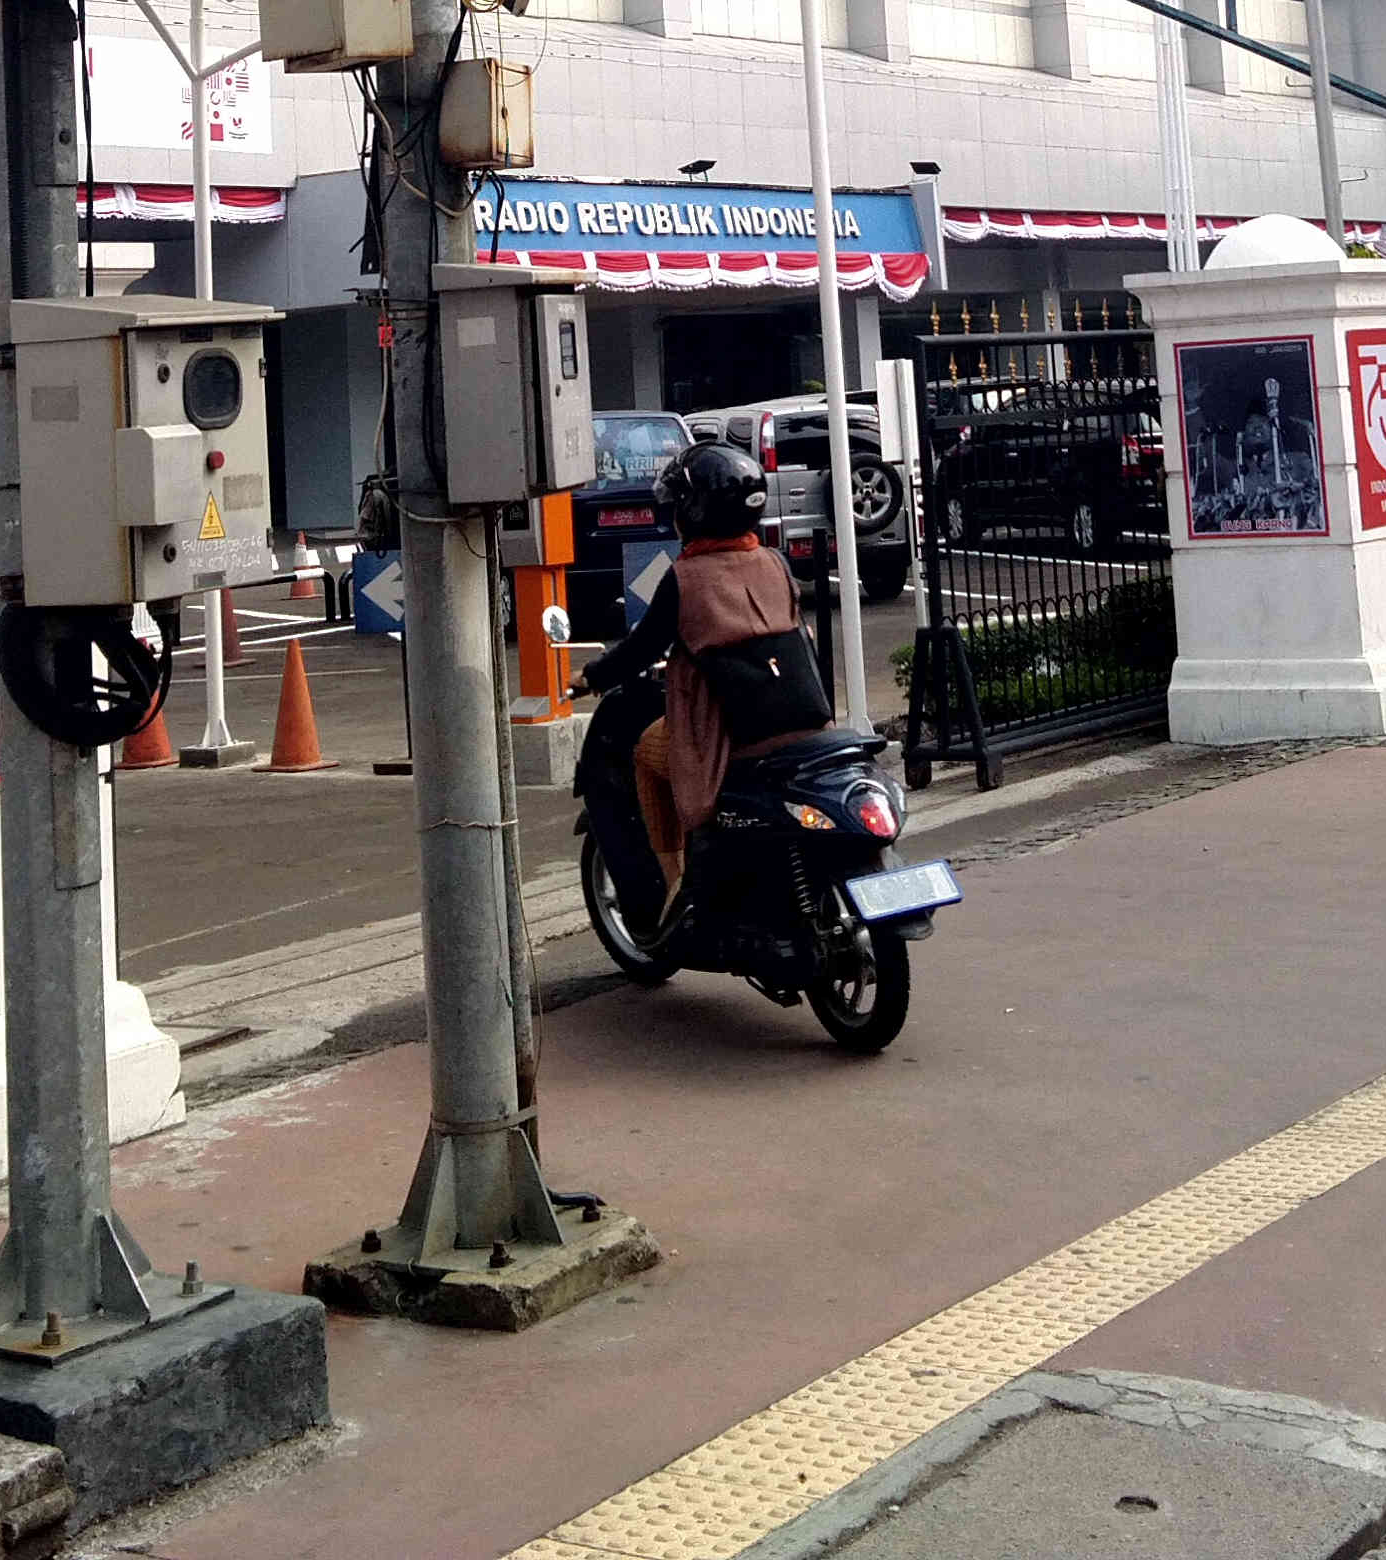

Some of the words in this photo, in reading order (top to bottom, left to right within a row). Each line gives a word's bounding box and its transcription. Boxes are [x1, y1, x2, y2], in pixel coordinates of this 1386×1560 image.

[473, 199, 570, 233] RADIO
[577, 201, 719, 236] REPUBLIK
[721, 204, 861, 239] INDONEIA
